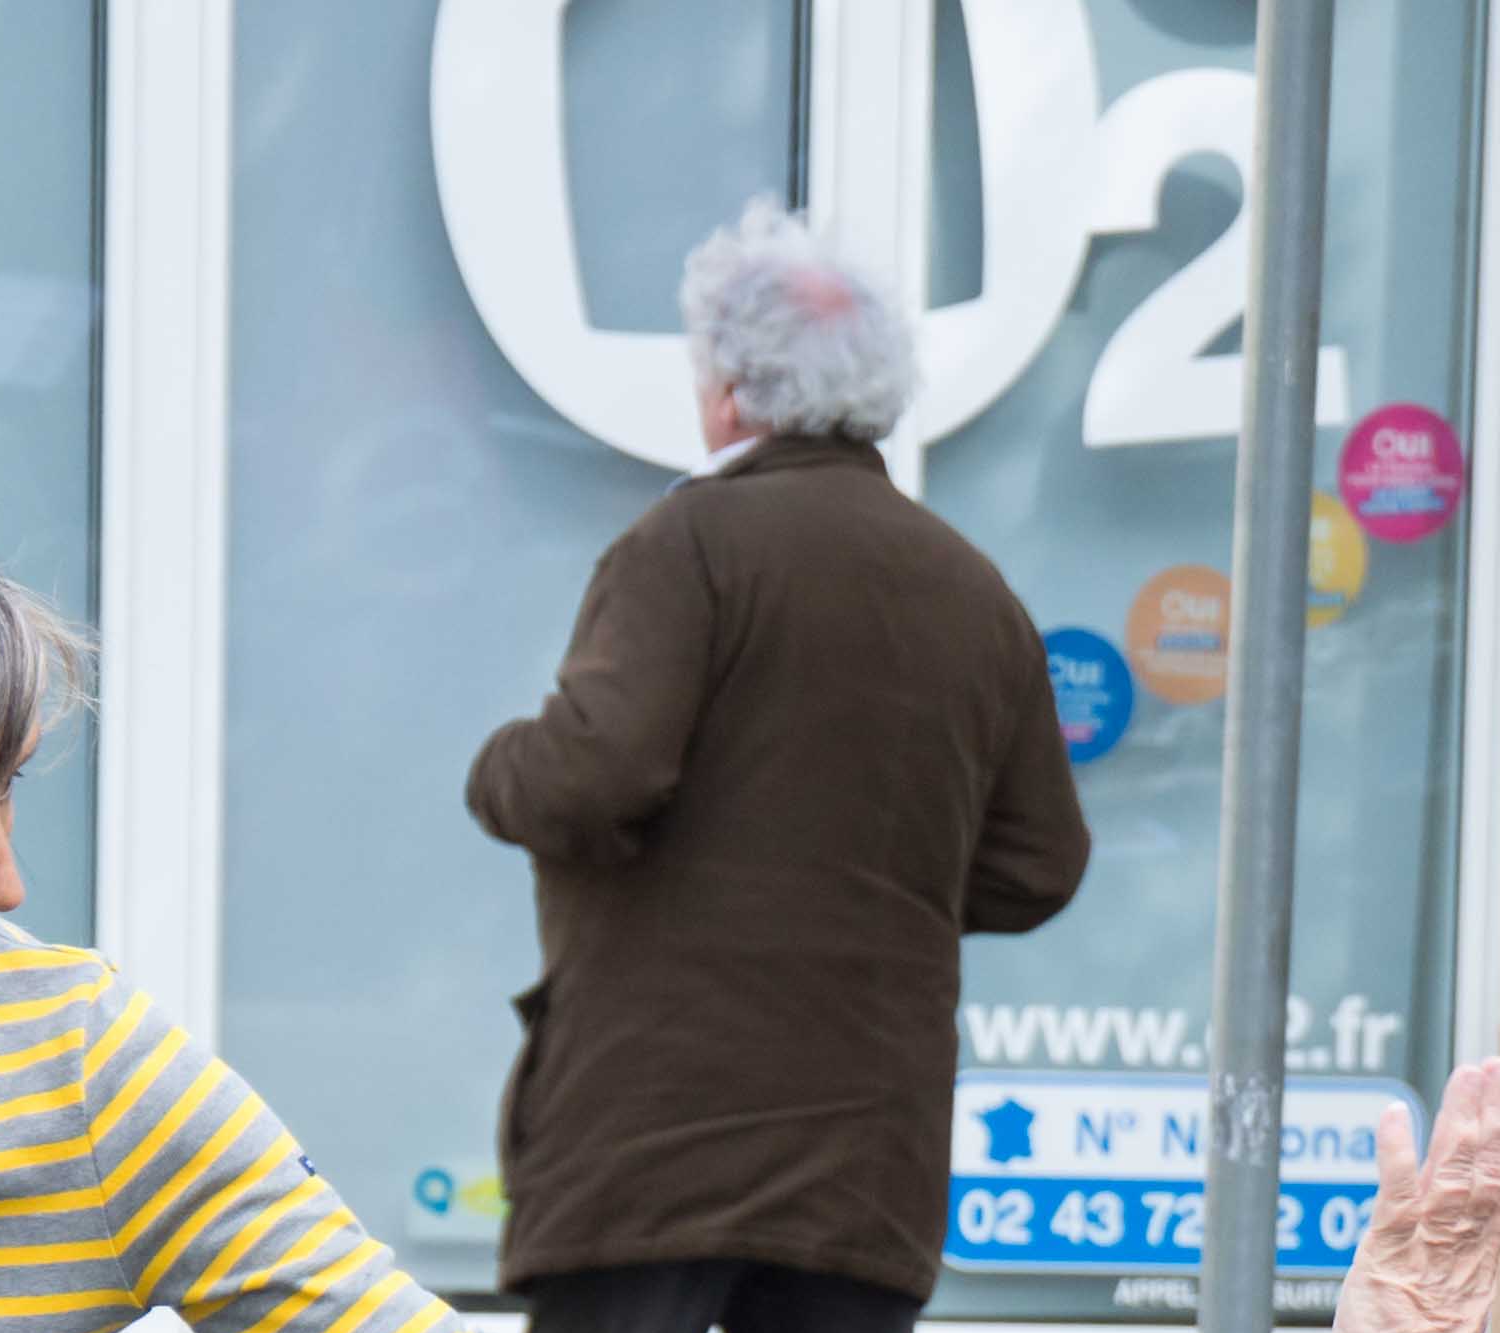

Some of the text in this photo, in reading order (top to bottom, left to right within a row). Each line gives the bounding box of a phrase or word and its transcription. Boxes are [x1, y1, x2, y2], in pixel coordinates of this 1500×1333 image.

[963, 996, 1400, 1070] www.2.fr
[957, 1189, 1034, 1246] 02
[1050, 1191, 1125, 1247] 43
